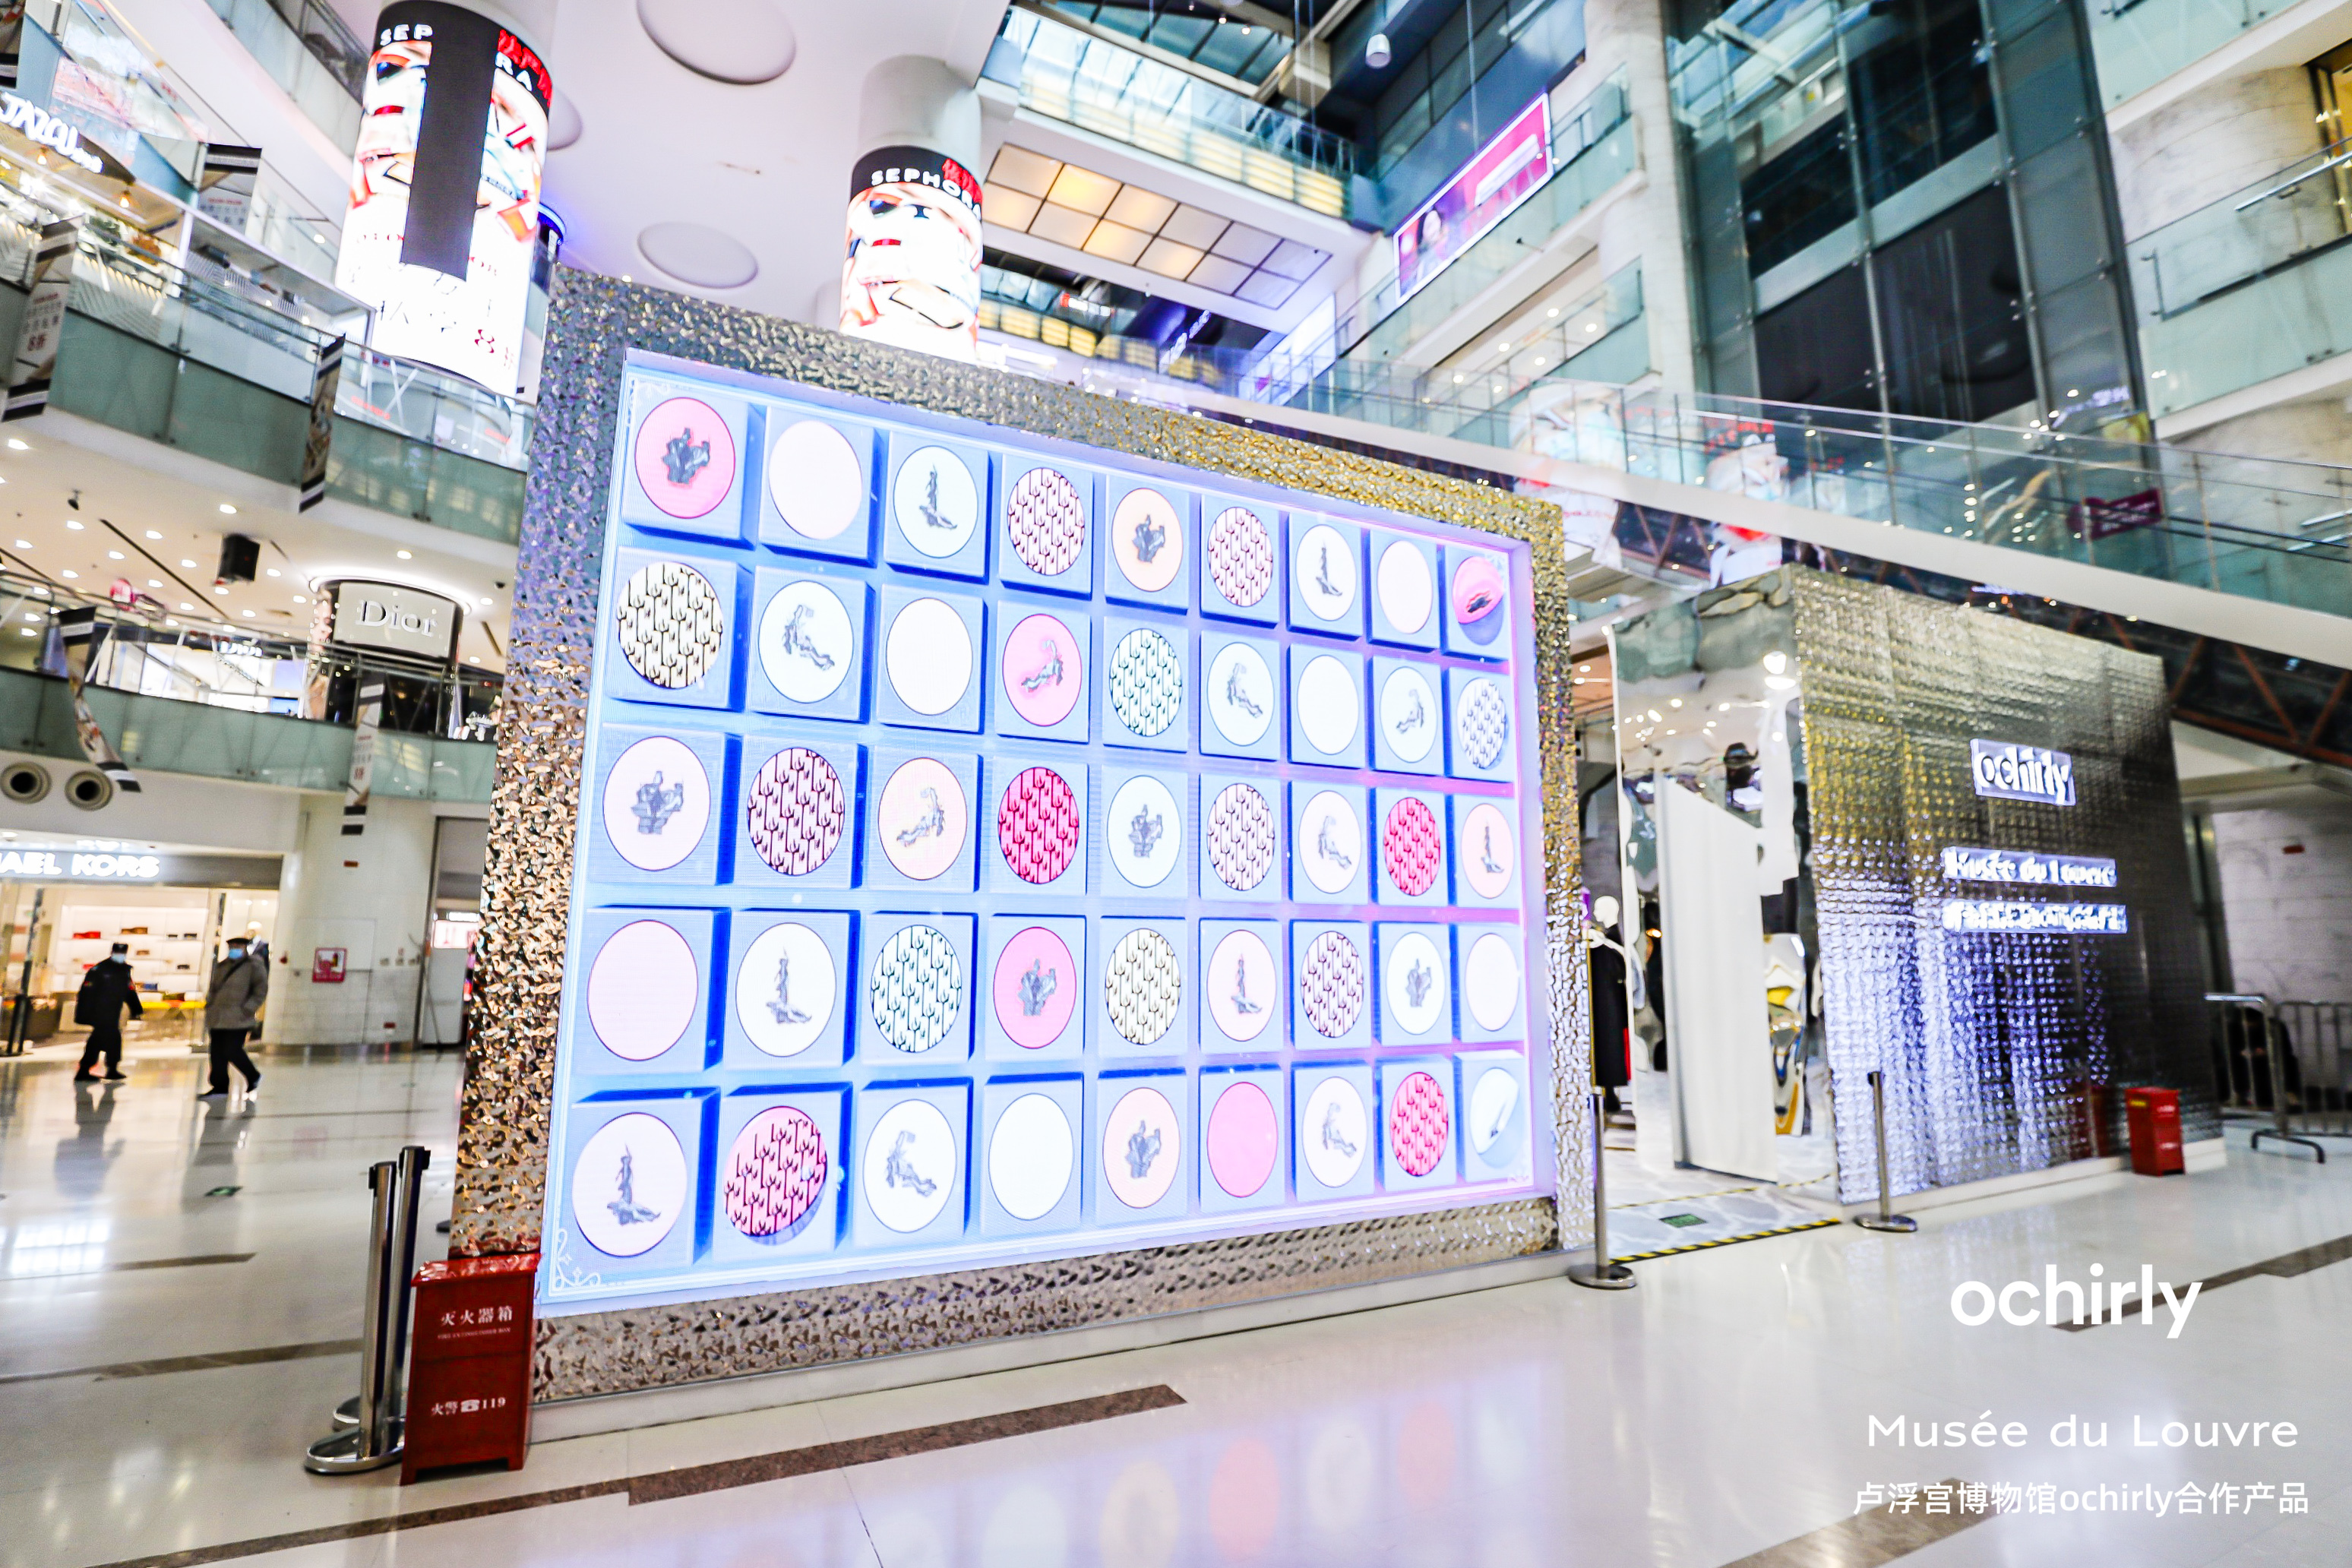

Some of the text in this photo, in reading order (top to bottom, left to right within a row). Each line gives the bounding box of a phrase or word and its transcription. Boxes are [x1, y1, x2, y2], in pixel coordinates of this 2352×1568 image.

[355, 599, 438, 637] Dior
[1974, 745, 2070, 806] ochirly
[0, 851, 160, 878] AEL KORS
[441, 1305, 513, 1327] 灭火器箱
[482, 1396, 507, 1410] 119
